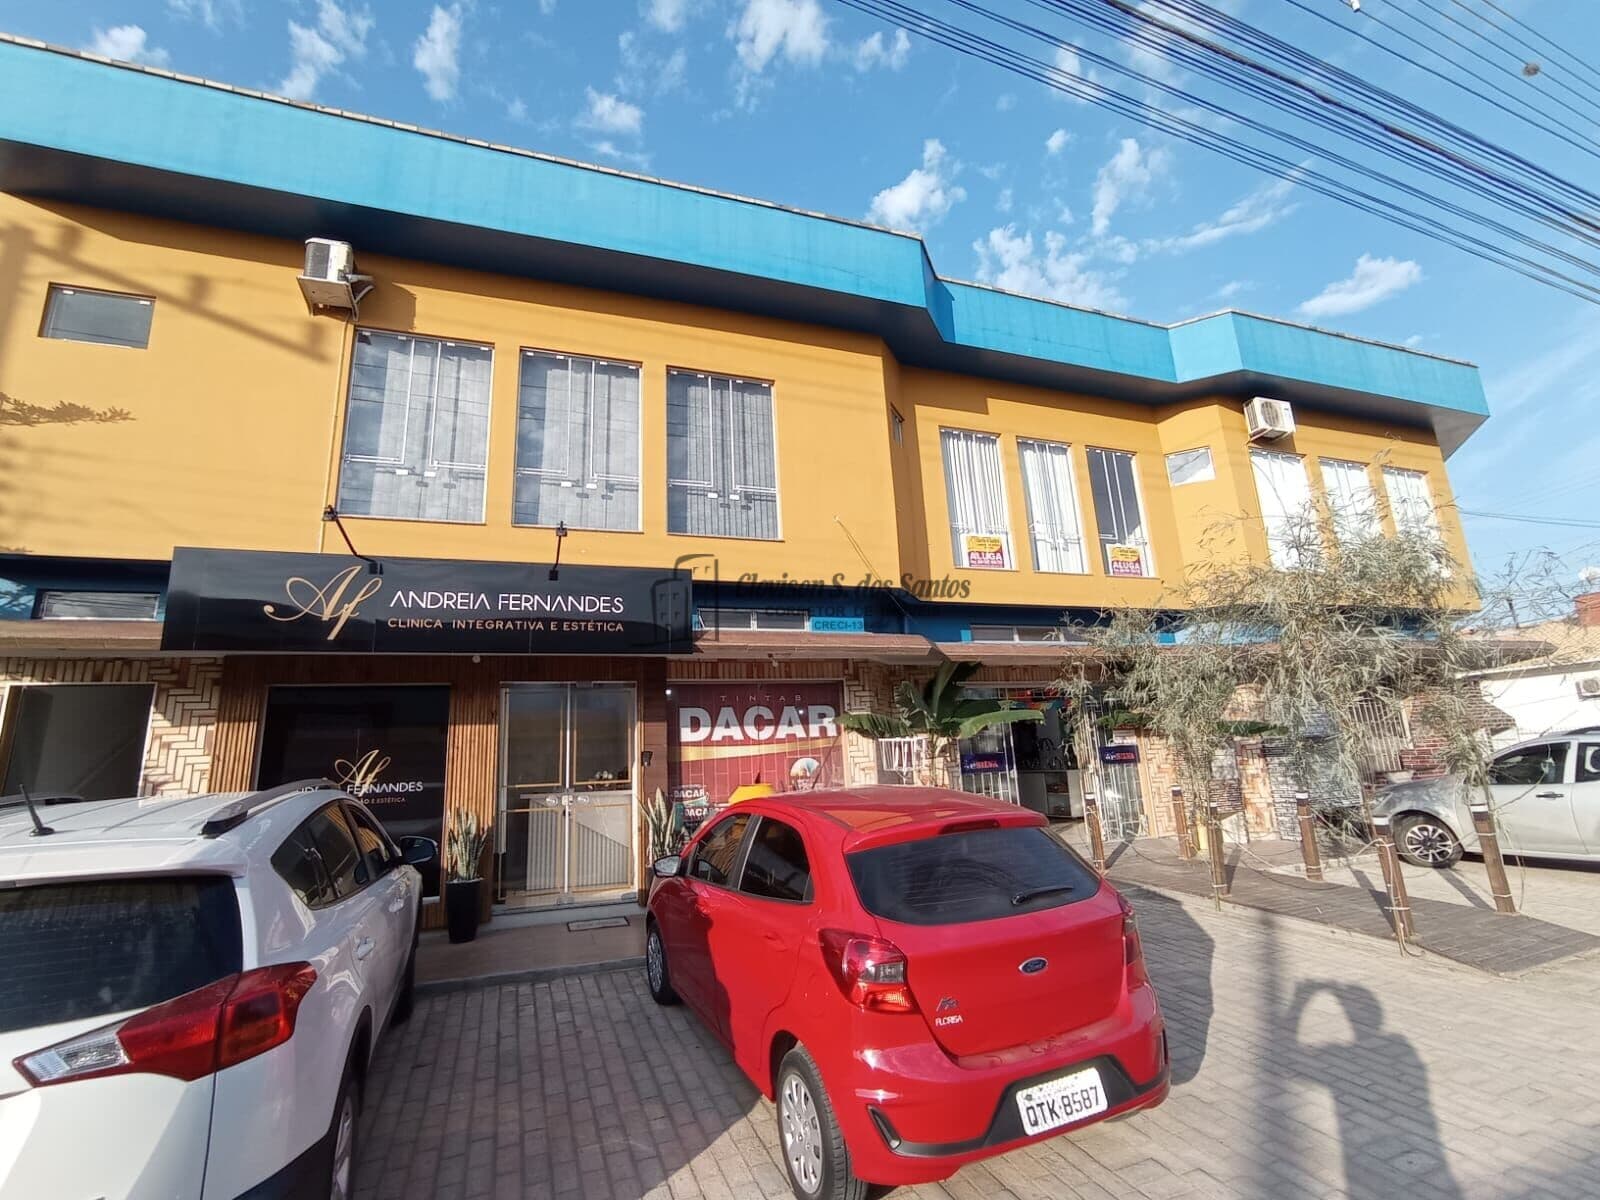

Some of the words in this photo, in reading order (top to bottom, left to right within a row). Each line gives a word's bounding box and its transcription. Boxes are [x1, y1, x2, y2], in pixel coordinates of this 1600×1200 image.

[970, 552, 1002, 560] ALUGA
[1113, 561, 1140, 570] ALUGA
[389, 590, 490, 610] ANDREIA
[498, 593, 624, 613] FERNANDES
[387, 617, 443, 629] CLINICA
[452, 618, 544, 631] INTEGRATIVA
[550, 620, 558, 631] E
[563, 618, 624, 632] ESTÉTICA
[679, 705, 838, 742] DACAR
[346, 781, 424, 794] FERNANDES
